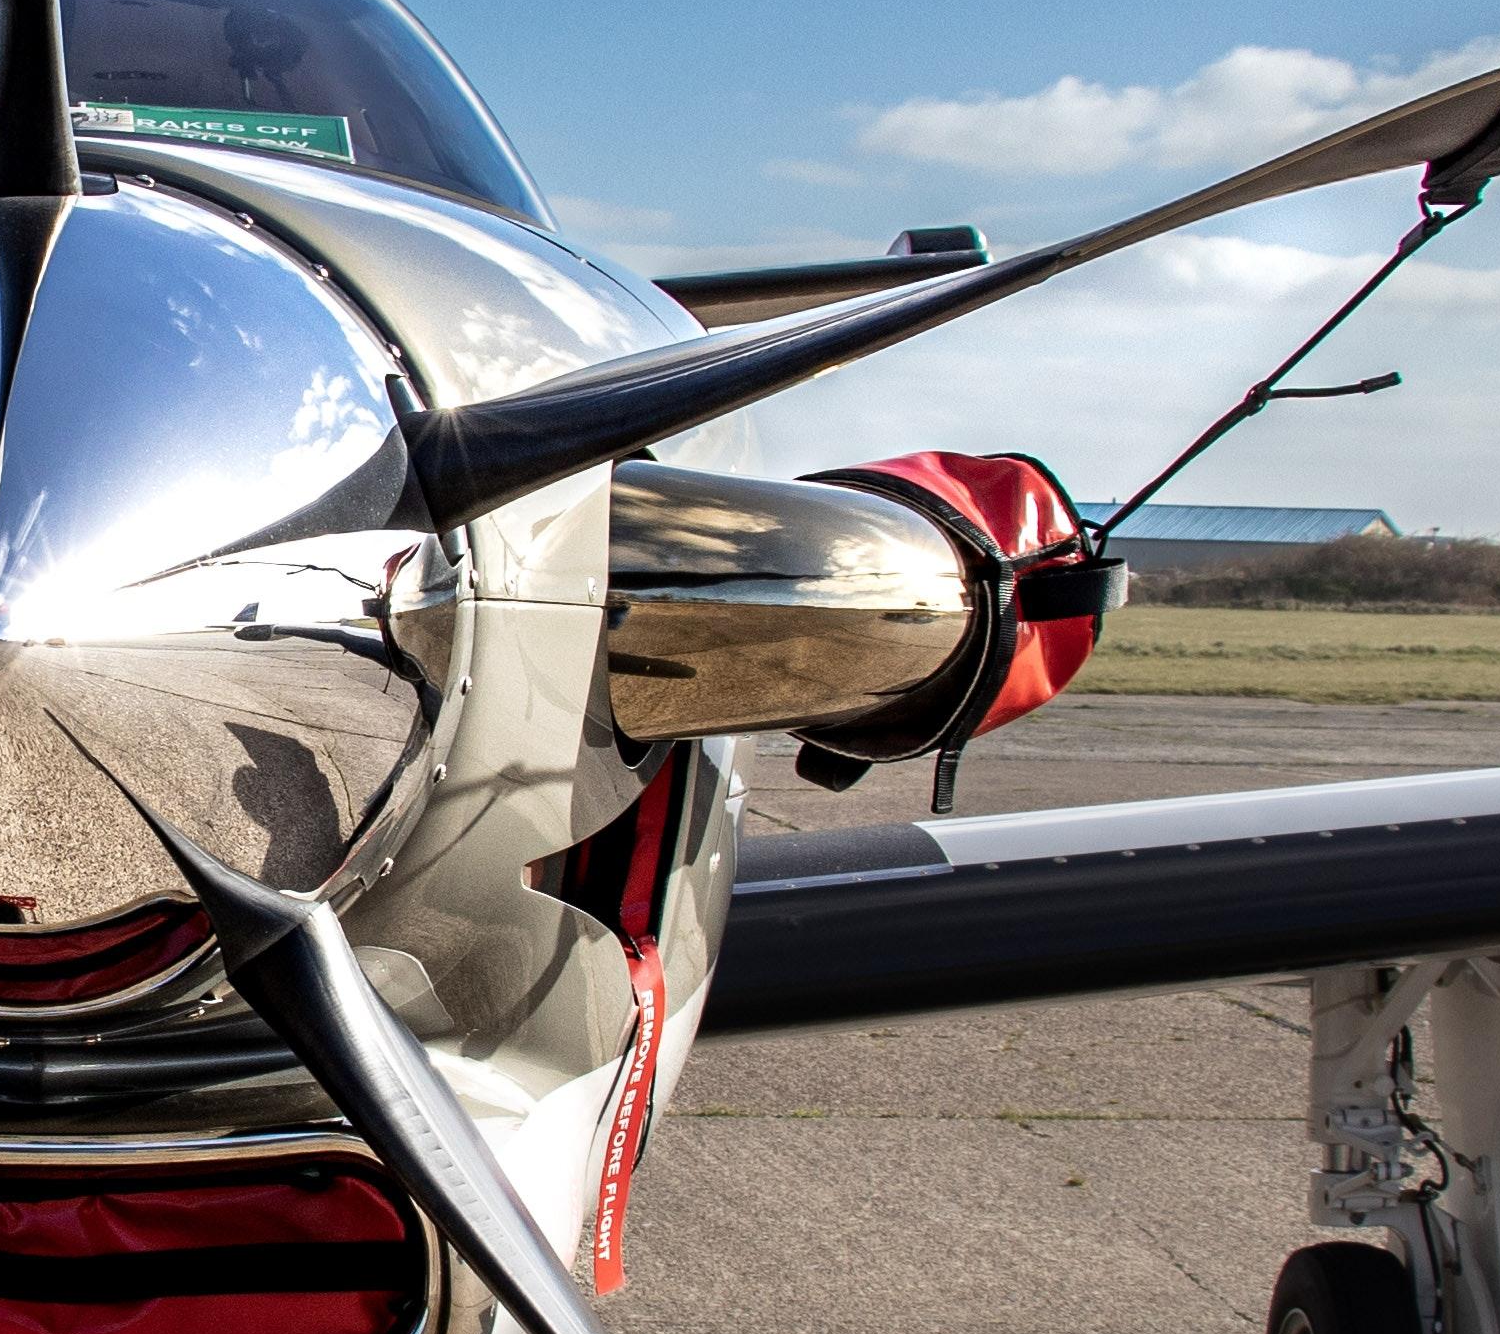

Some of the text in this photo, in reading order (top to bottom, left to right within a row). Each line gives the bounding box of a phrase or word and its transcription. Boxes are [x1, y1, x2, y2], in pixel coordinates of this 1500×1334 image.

[136, 118, 246, 134] RAKES
[256, 125, 319, 137] OFF
[598, 990, 654, 1260] REMOVE BEFORE FLIGHT
